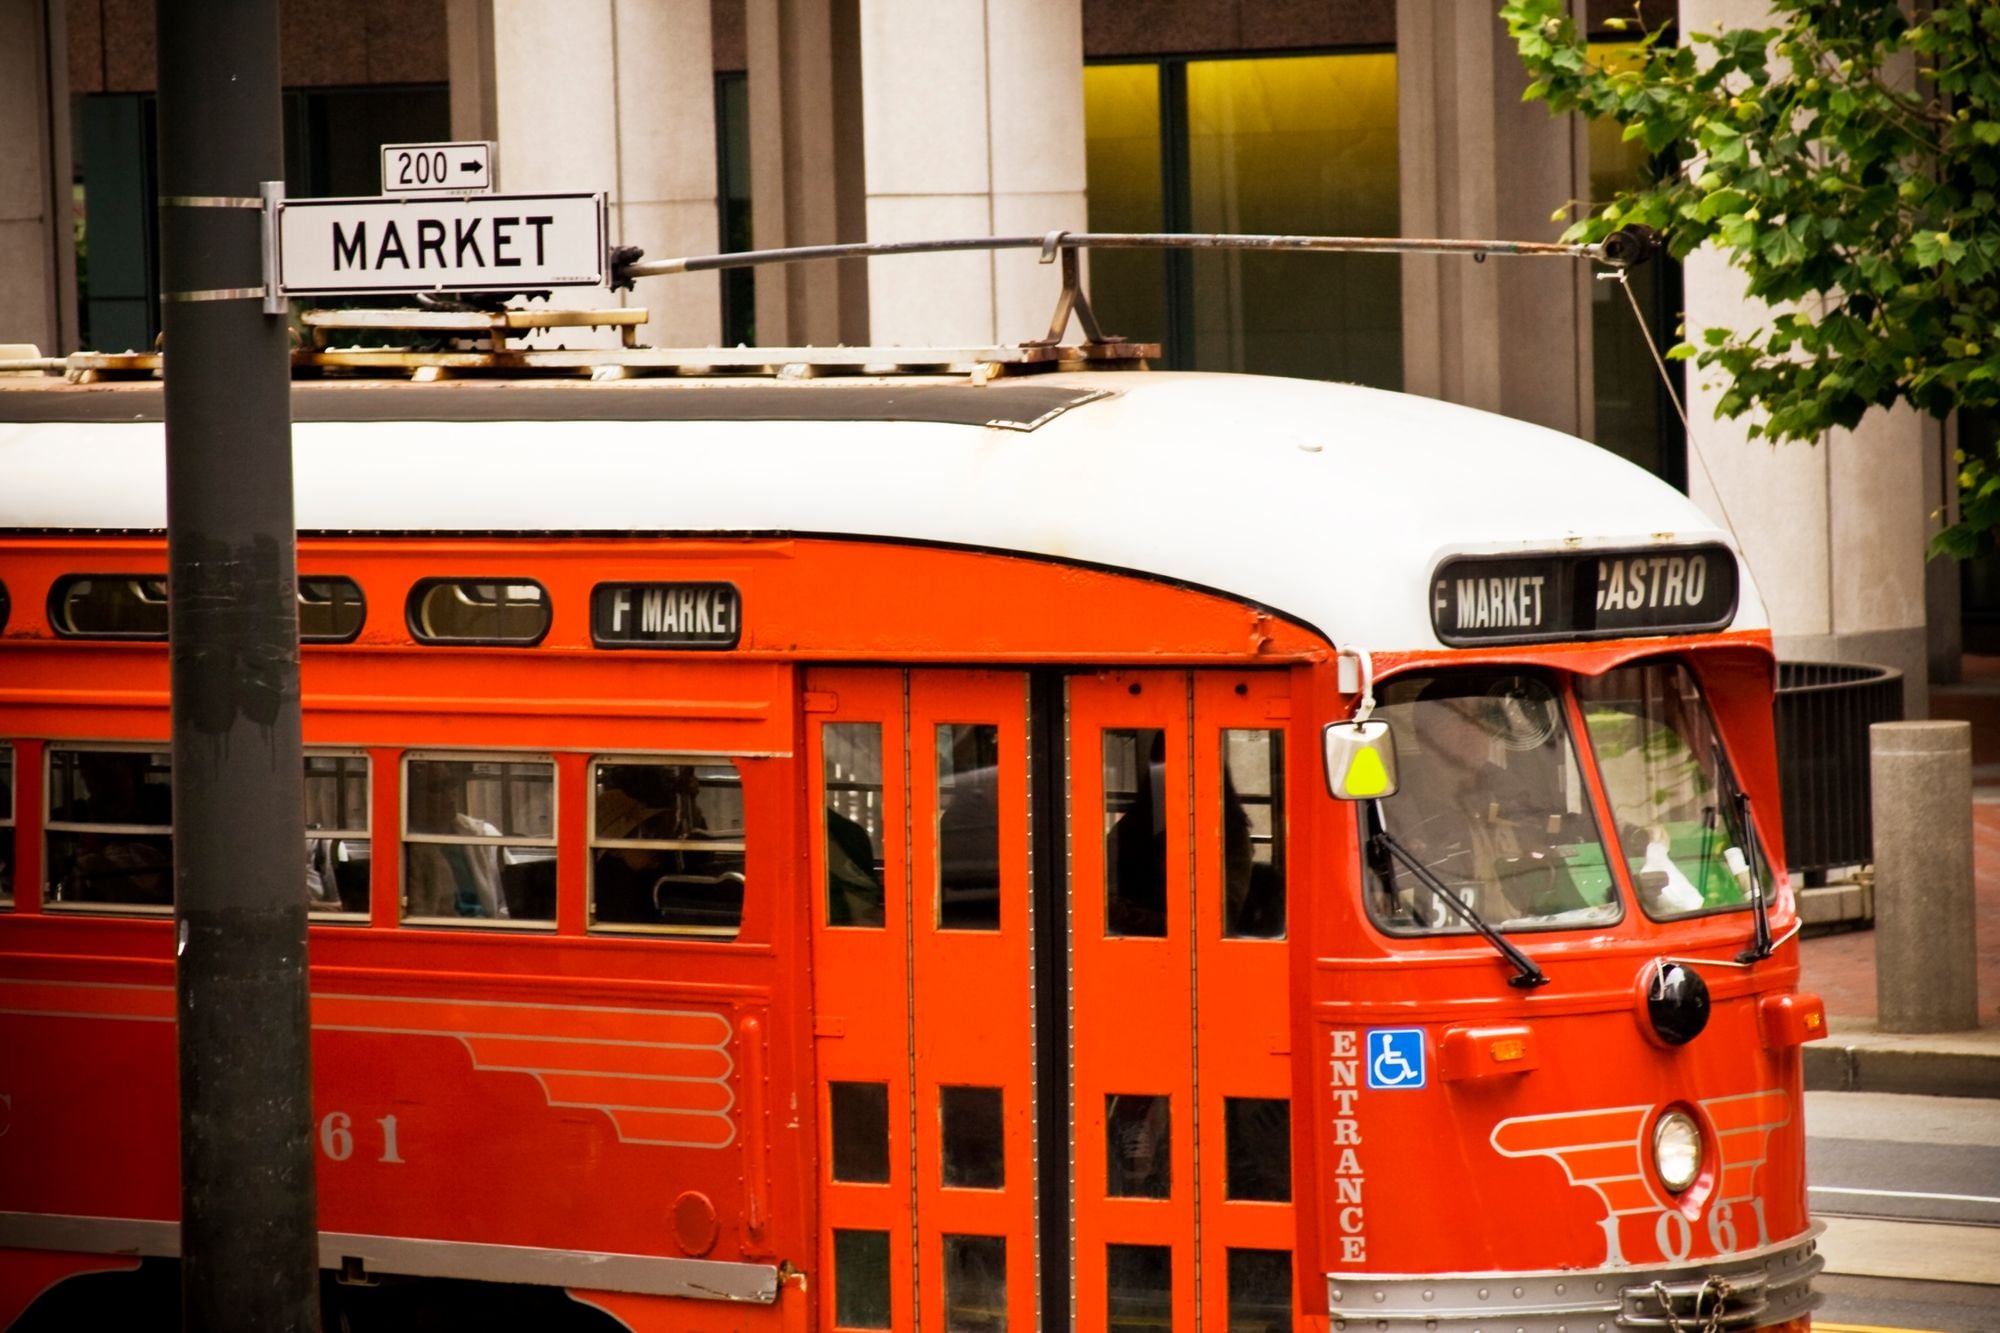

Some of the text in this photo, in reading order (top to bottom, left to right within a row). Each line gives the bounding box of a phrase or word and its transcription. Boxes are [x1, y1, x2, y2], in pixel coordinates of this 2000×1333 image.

[398, 151, 448, 185] 200
[331, 215, 554, 271] MARKET
[613, 588, 631, 632] F
[1434, 579, 1448, 625] F
[1456, 576, 1545, 629] MARKET
[1330, 1030, 1367, 1262] ENTRANCE
[1596, 1196, 1772, 1270] 1061
